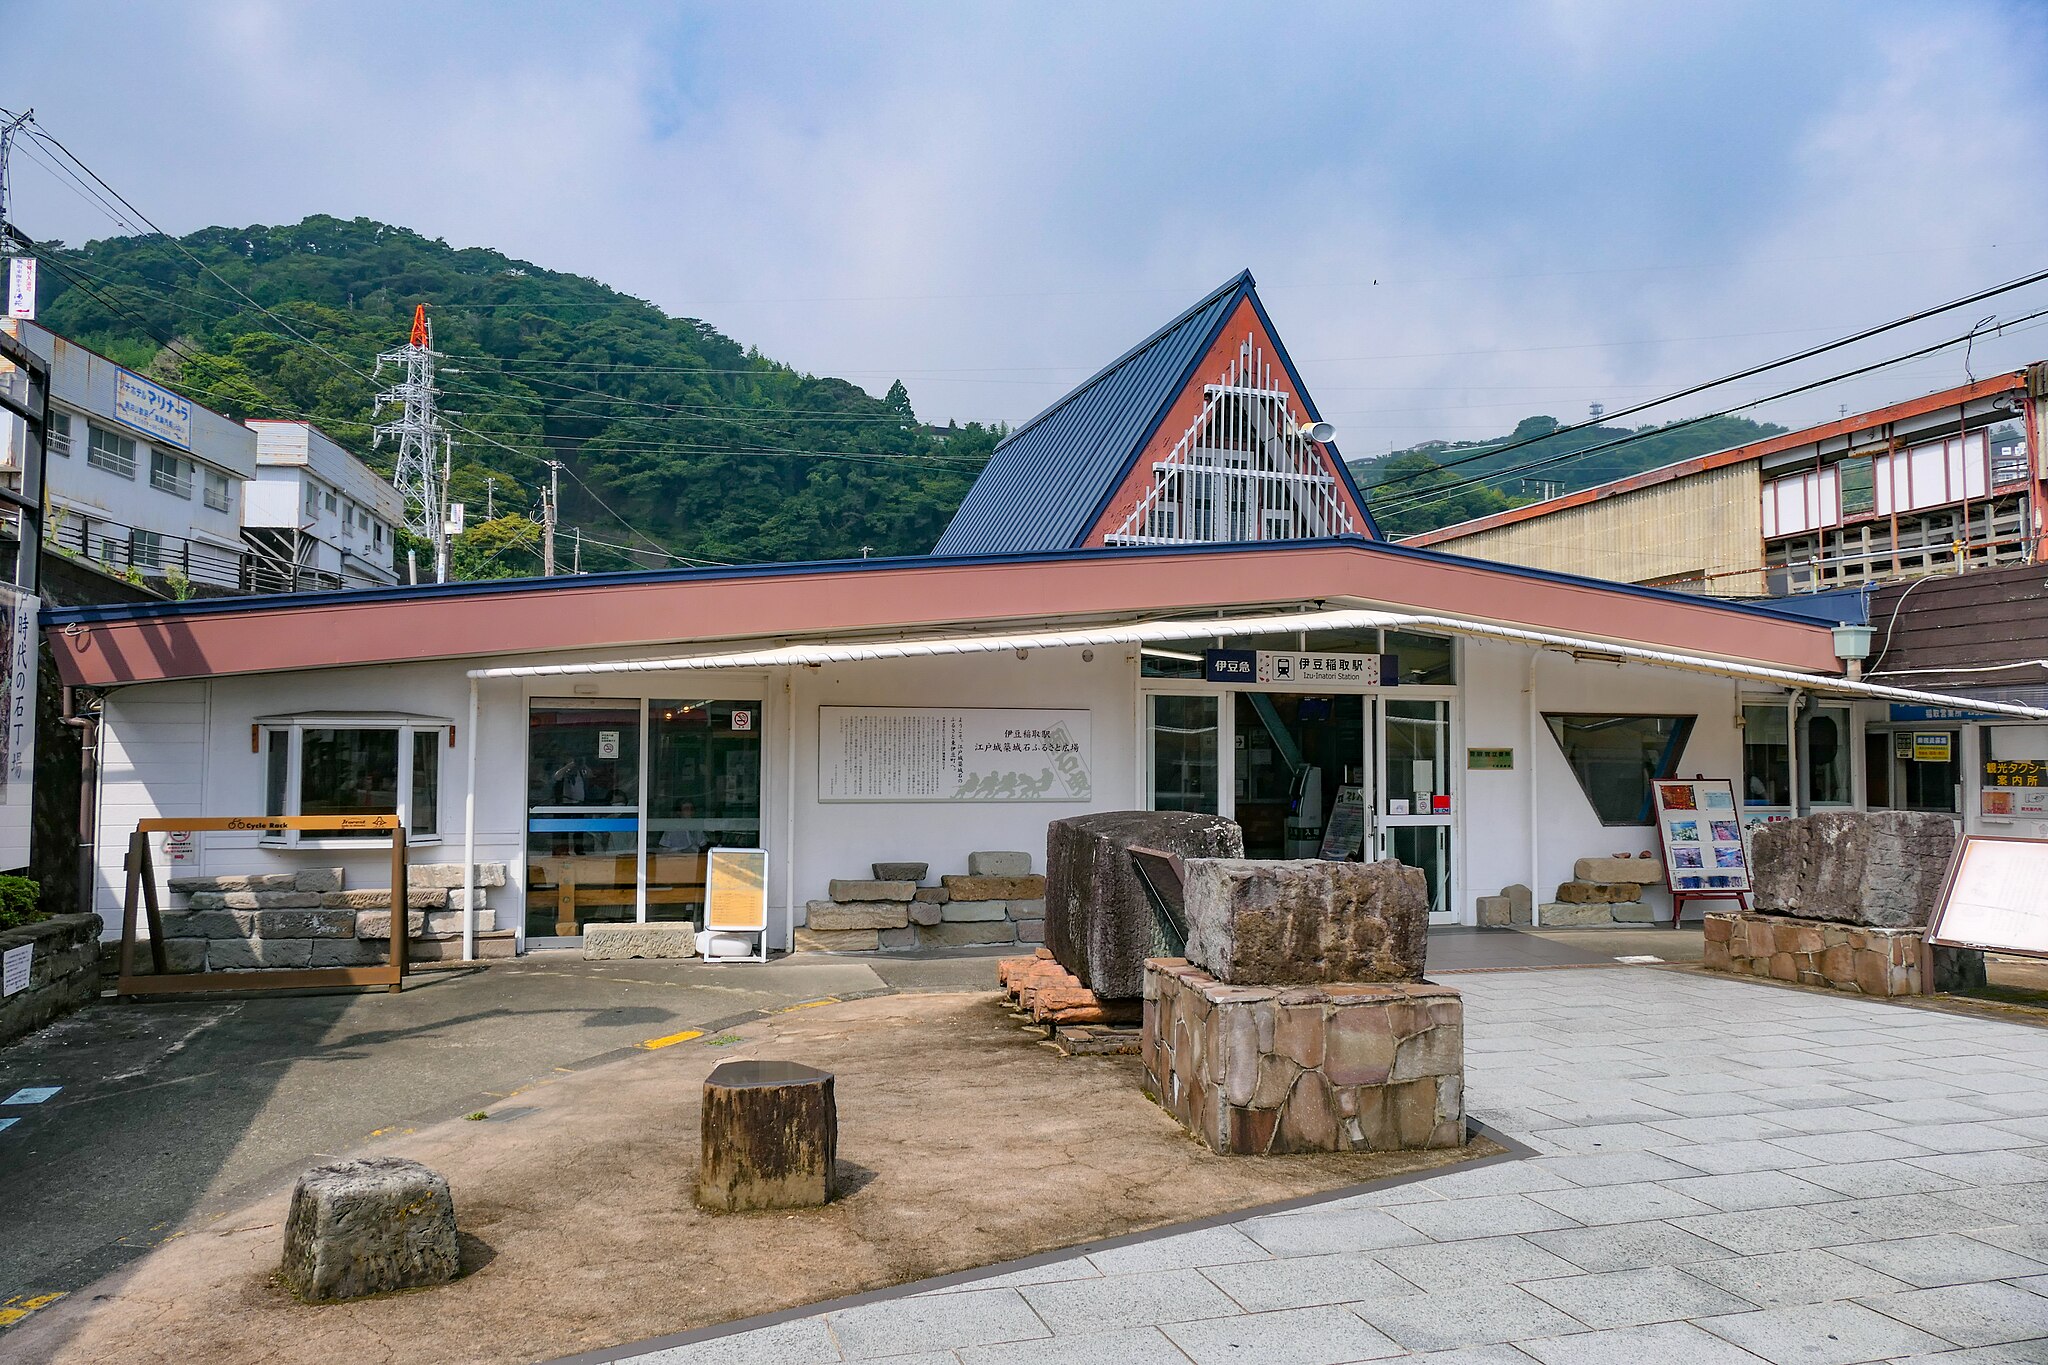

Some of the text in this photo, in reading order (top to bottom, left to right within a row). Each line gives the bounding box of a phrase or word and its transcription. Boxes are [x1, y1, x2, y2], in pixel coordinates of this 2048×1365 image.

[1215, 660, 1250, 673] 伊豆急
[1299, 658, 1363, 671] 伊豆稲取駅
[1304, 672, 1337, 680] Izu-Inatori
[1004, 729, 1051, 739] 伊豆稲取駅
[974, 743, 1080, 752] 江戸城築城石ふるさと広場
[1986, 762, 2048, 774] 観光タクシー
[1997, 775, 2038, 787] 案内所
